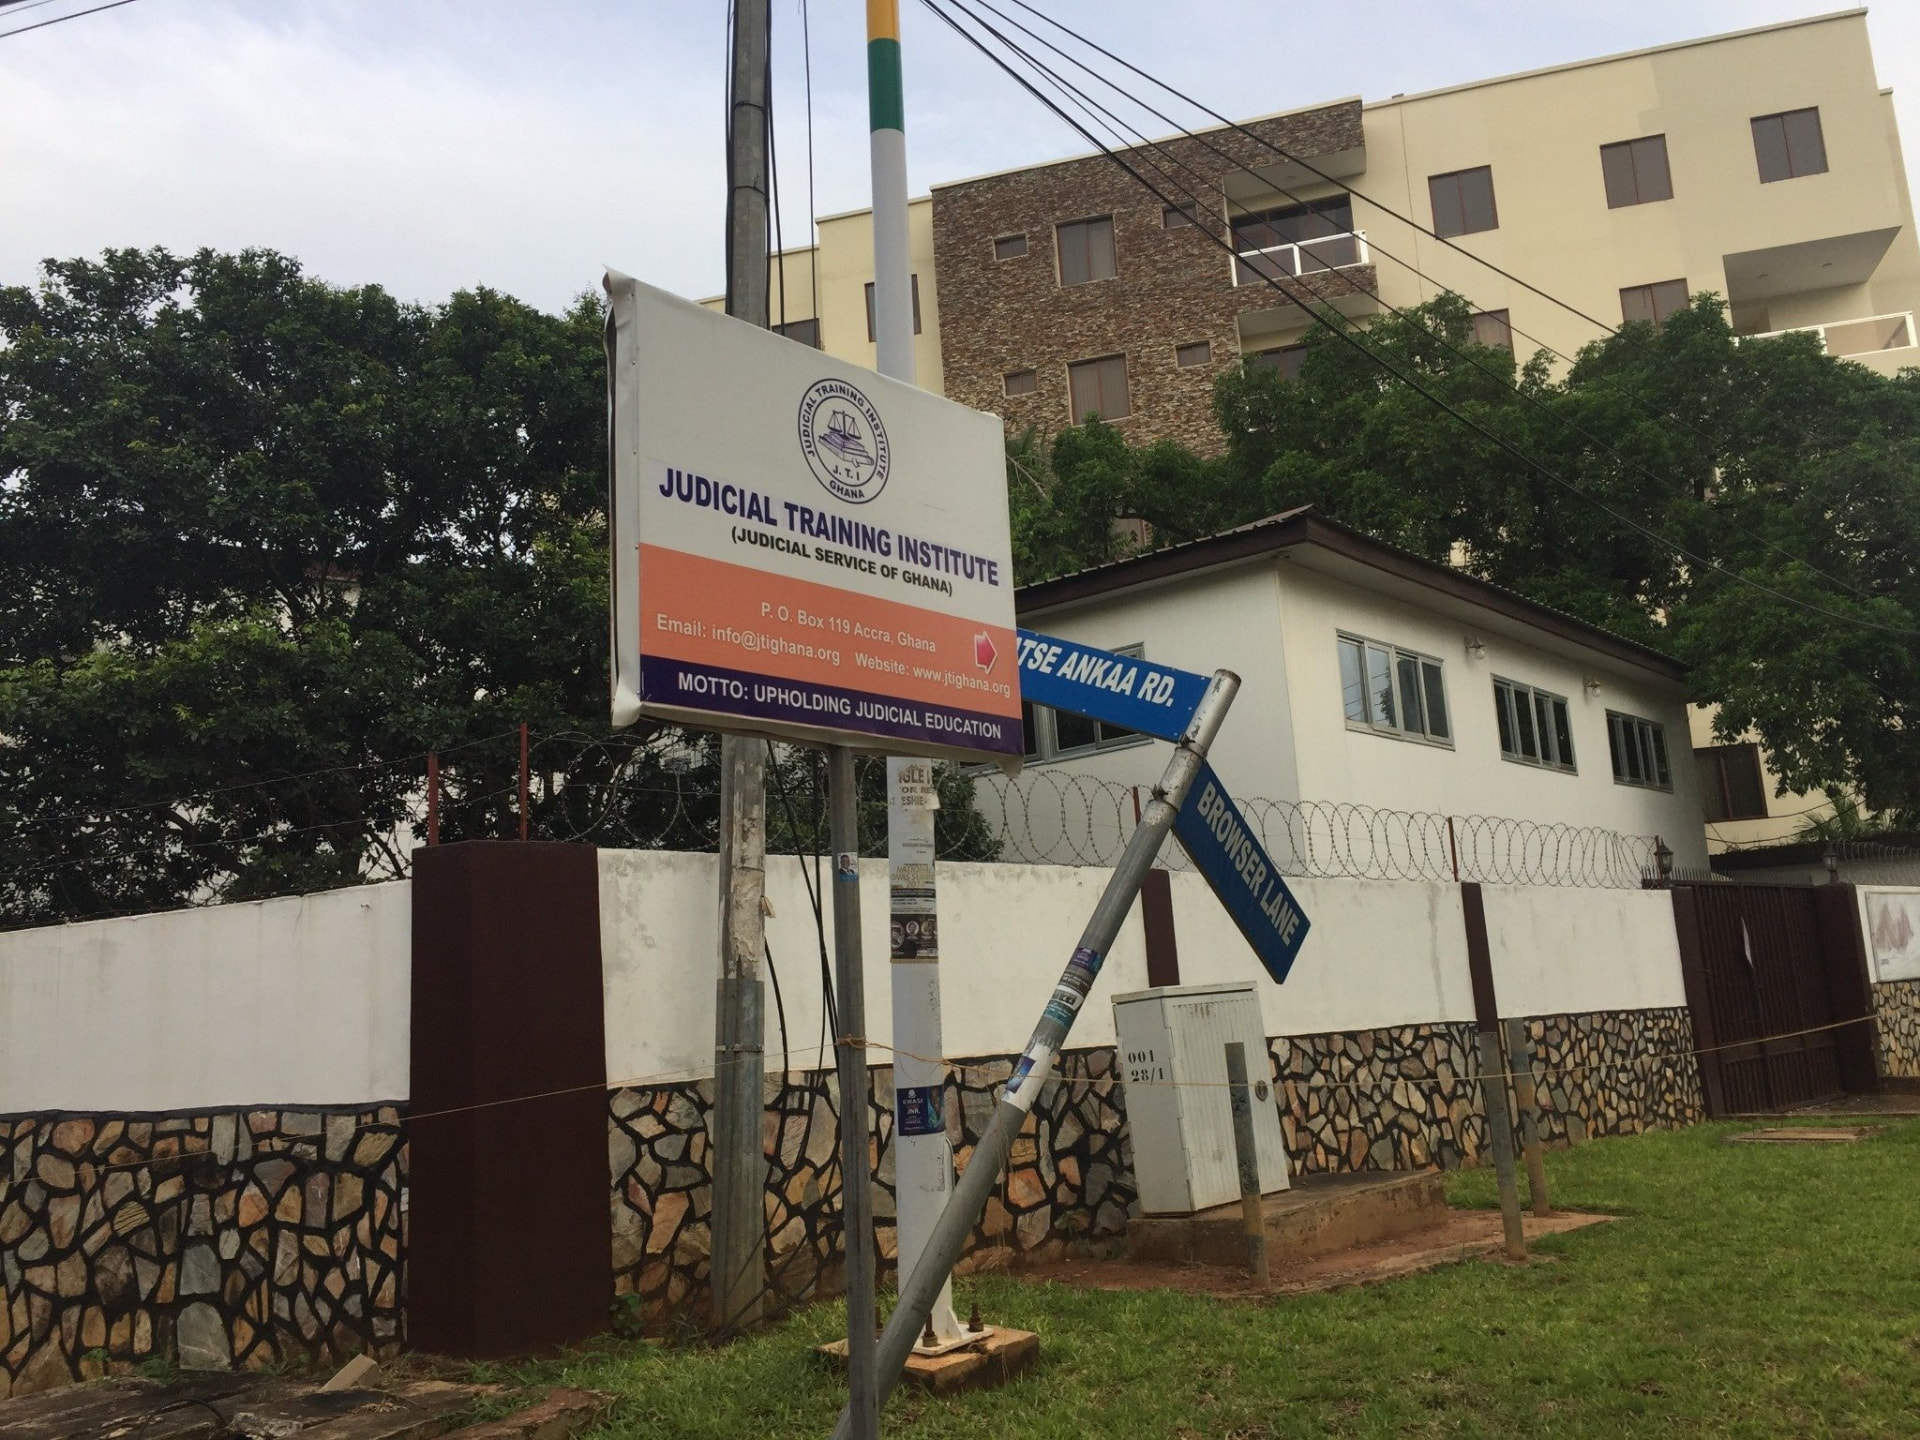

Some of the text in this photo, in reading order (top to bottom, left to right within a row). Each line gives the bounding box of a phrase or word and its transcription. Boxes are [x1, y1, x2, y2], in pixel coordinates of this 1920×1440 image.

[802, 384, 887, 480] JUDICIAL TRAINING INSTITUTE
[829, 480, 865, 499] GHANA
[659, 468, 999, 587] JUDICIAL TRAINING INSTITUTE
[731, 526, 953, 598] (JUDICIAL SERVICE OF GHANA)
[657, 613, 1011, 698] Email: info@jtighana.org Website: www.jtighana.org
[761, 602, 936, 652] P. O. Box 119 Accra, Ghana
[678, 672, 1001, 740] MOTTO: UPHOLDING JUDICIAL EDUCATION
[1056, 651, 1138, 696] ANKAA
[1137, 675, 1174, 708] RD.
[1197, 782, 1300, 947] BROWSER LANE
[1128, 1050, 1155, 1064] 001
[1131, 1067, 1164, 1086] 28/1
